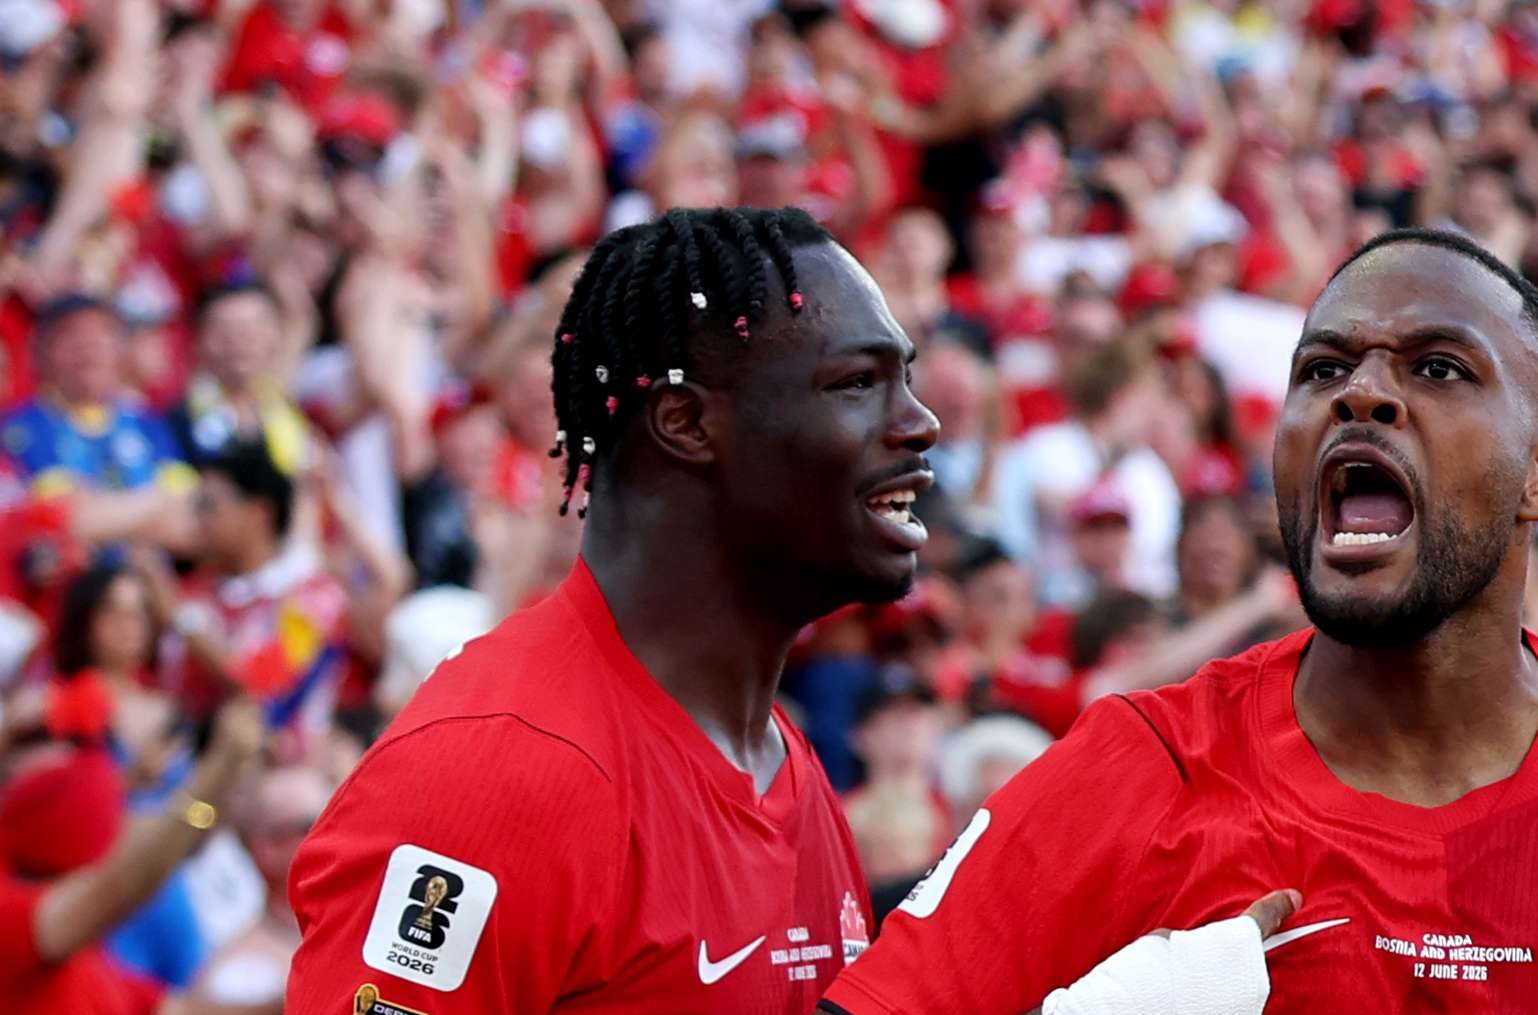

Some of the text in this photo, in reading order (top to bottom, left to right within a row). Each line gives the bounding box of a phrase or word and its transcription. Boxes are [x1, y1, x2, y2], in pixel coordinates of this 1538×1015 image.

[407, 926, 432, 943] FIFA
[1422, 934, 1472, 947] CANADA
[391, 941, 439, 962] WORLD CUP
[1375, 935, 1533, 963] BOSNIA AND HERZEGOVINA
[386, 950, 435, 975] 2026
[1413, 963, 1488, 981] 12 JUNE 2026
